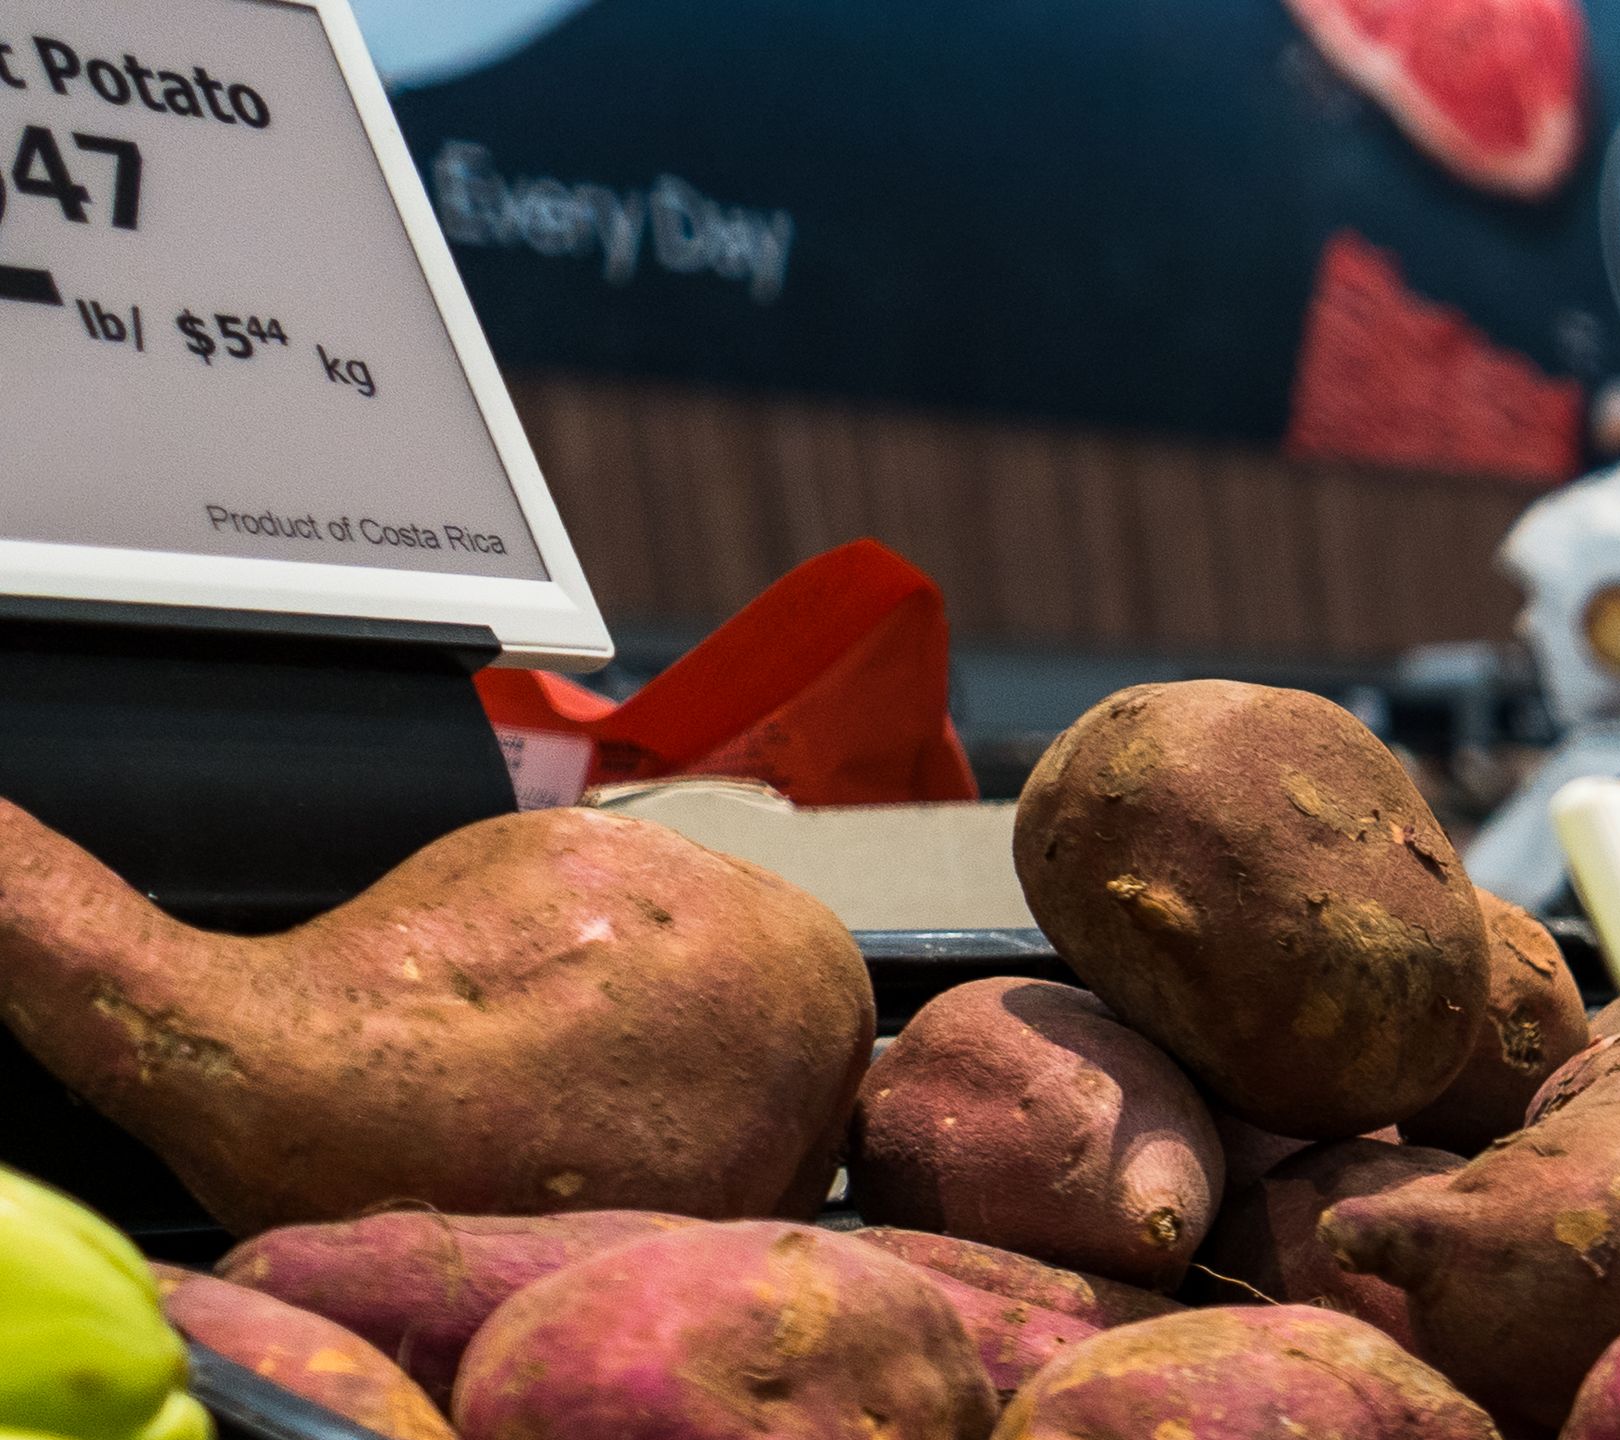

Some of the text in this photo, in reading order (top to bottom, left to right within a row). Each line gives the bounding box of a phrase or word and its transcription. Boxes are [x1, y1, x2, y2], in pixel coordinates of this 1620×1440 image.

[32, 36, 271, 129] Potato
[431, 140, 795, 305] Every Day
[316, 343, 376, 398] kg
[206, 504, 508, 555] Product of Costa Rica
